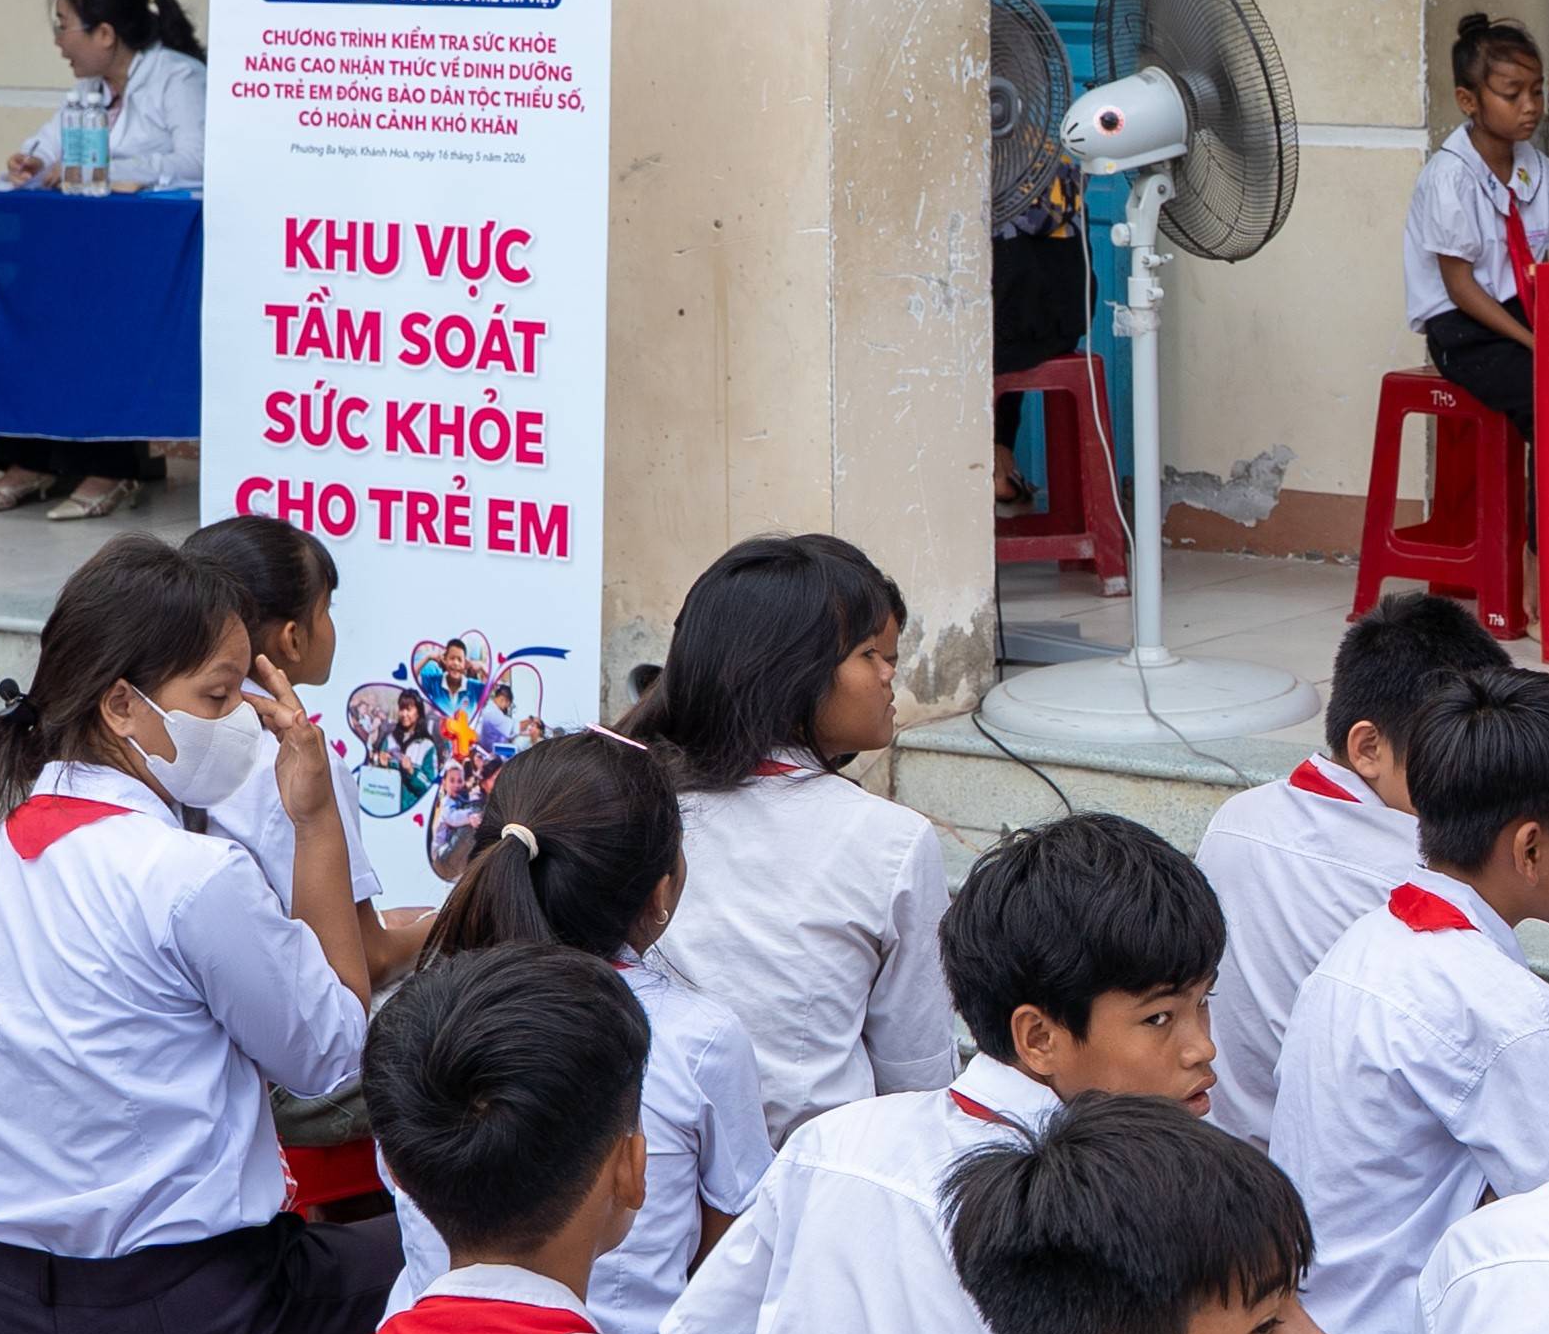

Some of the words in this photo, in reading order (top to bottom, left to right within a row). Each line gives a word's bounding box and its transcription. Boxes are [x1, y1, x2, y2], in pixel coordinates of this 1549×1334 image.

[262, 29, 336, 47] CHƯƠNG
[340, 28, 387, 49] TRÌNH
[392, 25, 435, 50] KIỂM
[439, 34, 469, 52] TRA
[472, 29, 505, 53] SỨC
[509, 32, 557, 54] KHỎE
[245, 52, 296, 73] NÂNG
[300, 57, 336, 75] CAO
[340, 55, 385, 80] NHẬN
[389, 56, 437, 78] THỨC
[440, 54, 460, 78] VỀ
[463, 62, 505, 80] DINH
[509, 59, 573, 82] DƯỠNG
[231, 81, 271, 99] CHO
[274, 78, 305, 100] TRẺ
[309, 84, 333, 101] EM
[336, 81, 383, 103] ĐỒNG
[388, 82, 426, 104] BÀO
[430, 84, 466, 106] DÂN
[468, 85, 501, 111] TỘC
[504, 85, 553, 109] THIỂU
[557, 88, 586, 114] SỐ,
[298, 107, 323, 127] CÓ
[326, 108, 372, 129] HOÀN
[376, 109, 427, 131] CẢNH
[431, 110, 467, 133] KHÓ
[470, 113, 518, 135] KHĂN
[326, 144, 336, 155] Ba
[360, 146, 387, 158] Khánh
[413, 149, 436, 162] ngày
[450, 150, 473, 164] tháng
[284, 217, 401, 276] KHU
[415, 220, 533, 298] VỰC
[264, 286, 382, 363] TẦM
[398, 304, 547, 374] SOÁT
[263, 380, 370, 451] SỨC
[385, 388, 545, 465] KHỎE
[235, 476, 357, 537] CHO
[368, 475, 472, 548] TRẺ
[487, 498, 570, 558] EM
